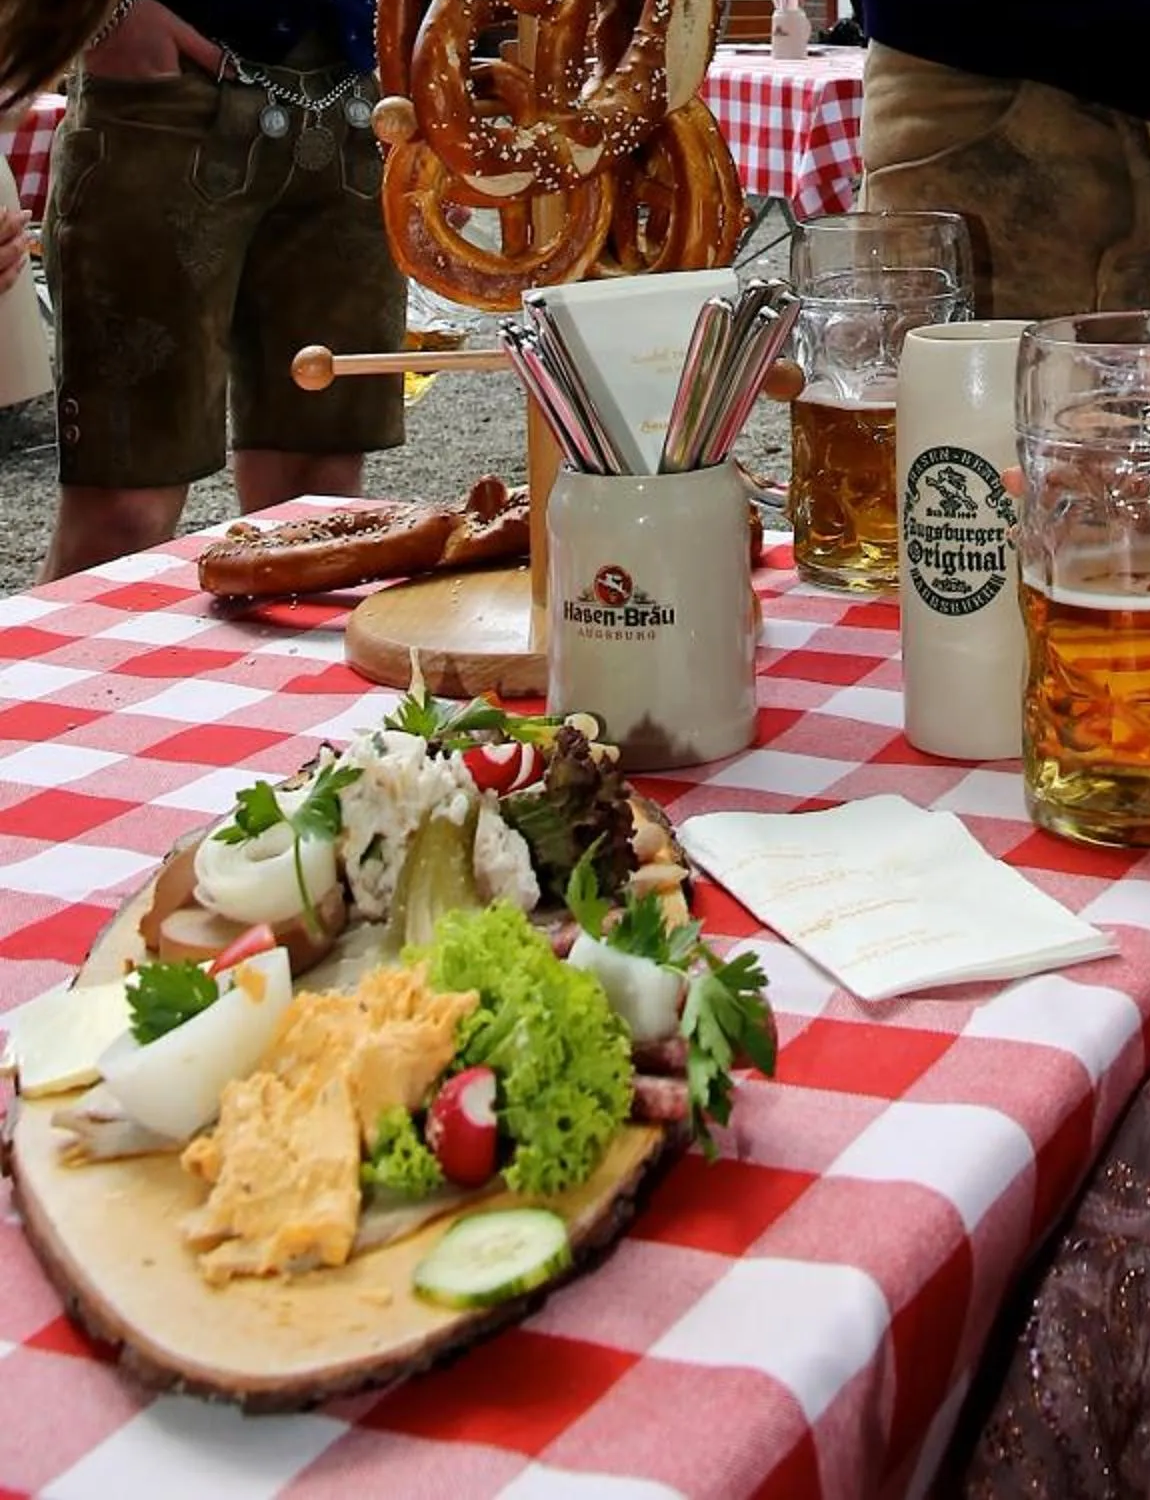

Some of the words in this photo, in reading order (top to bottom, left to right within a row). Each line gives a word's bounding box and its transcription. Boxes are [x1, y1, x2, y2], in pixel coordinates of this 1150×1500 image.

[907, 539, 1007, 576] Original
[563, 600, 676, 627] Hasen-Bräu
[577, 627, 657, 641] AUGSBURG
